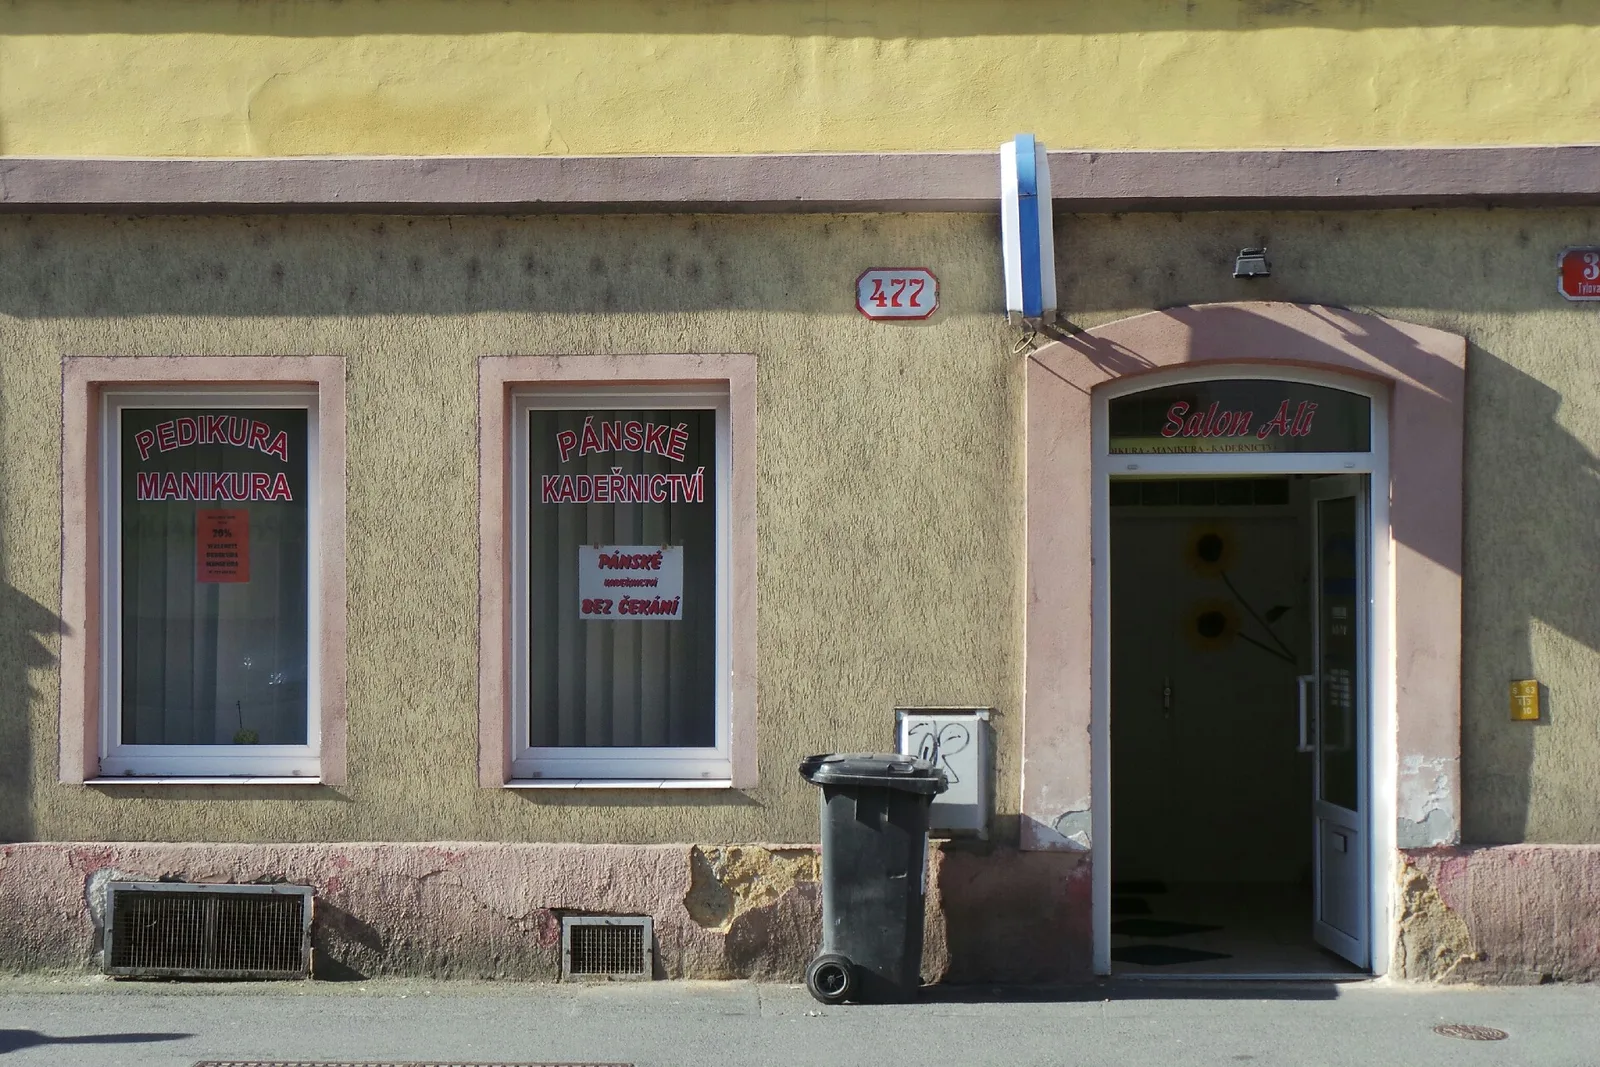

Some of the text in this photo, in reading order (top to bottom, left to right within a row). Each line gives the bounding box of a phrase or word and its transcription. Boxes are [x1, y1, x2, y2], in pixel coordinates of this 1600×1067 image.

[869, 278, 925, 307] 477
[1161, 399, 1318, 440] Salon Ali
[135, 415, 288, 462] PEDIKURA
[556, 415, 689, 463] PÁNSKÉ
[137, 472, 293, 501] MANIKURA
[541, 466, 705, 504] KADEŘNICTVÍ
[598, 550, 663, 570] PÁNSKÉ
[581, 595, 680, 615] BEZ ČEKÁNÍ
